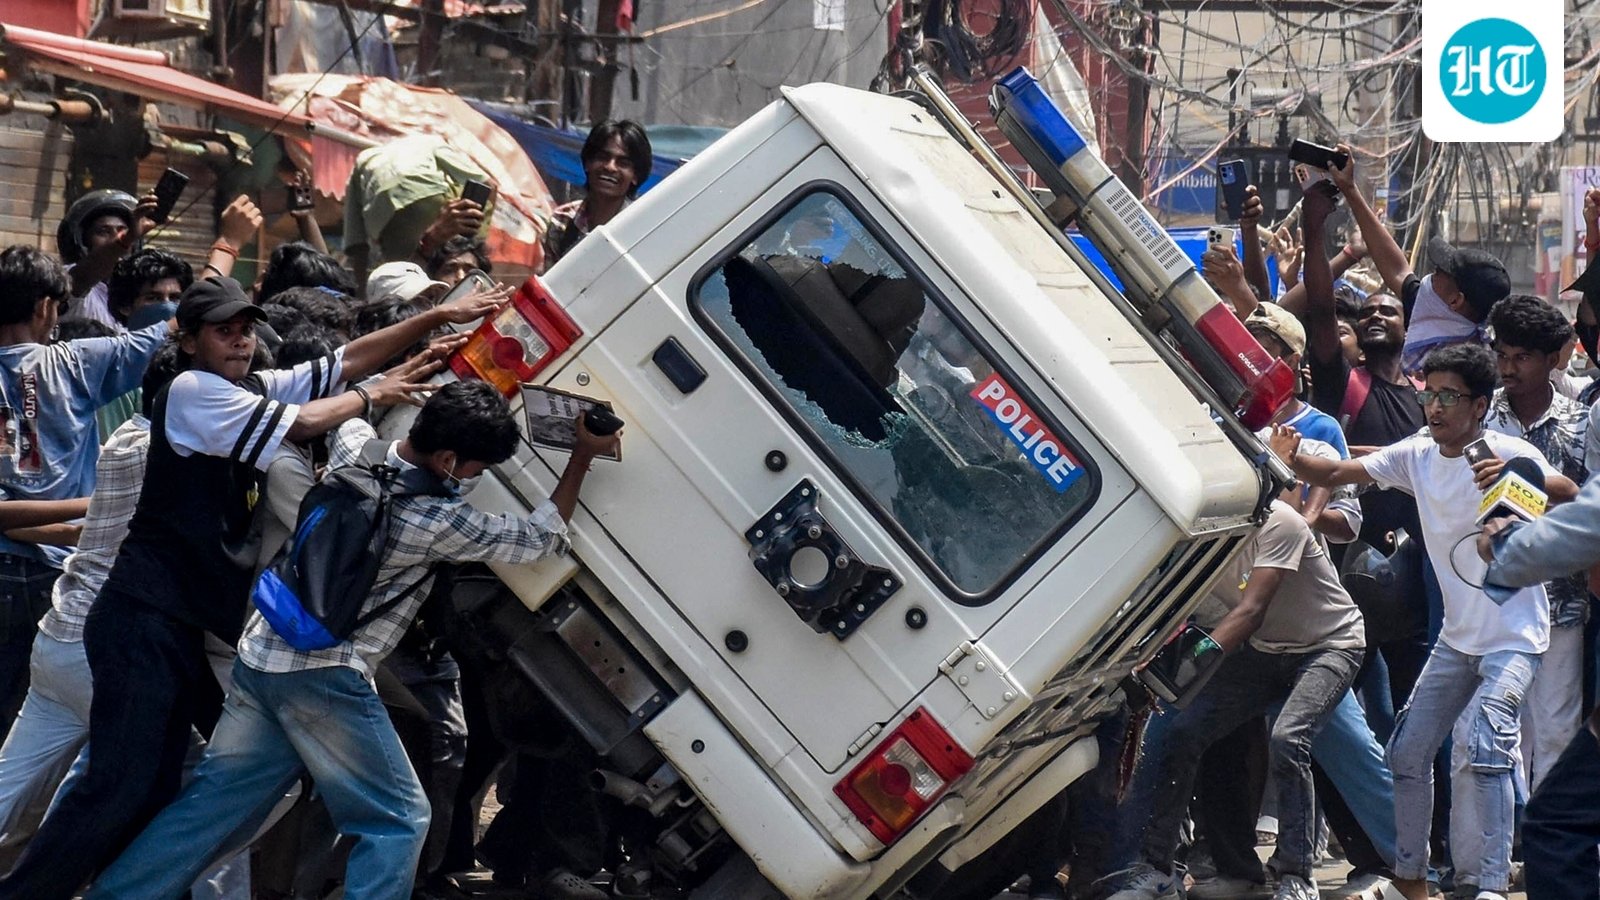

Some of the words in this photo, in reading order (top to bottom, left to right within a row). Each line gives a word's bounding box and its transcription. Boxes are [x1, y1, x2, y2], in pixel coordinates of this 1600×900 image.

[23, 374, 36, 418] NARUTO
[978, 380, 1076, 484] POLICE
[1510, 480, 1545, 506] ROJ
